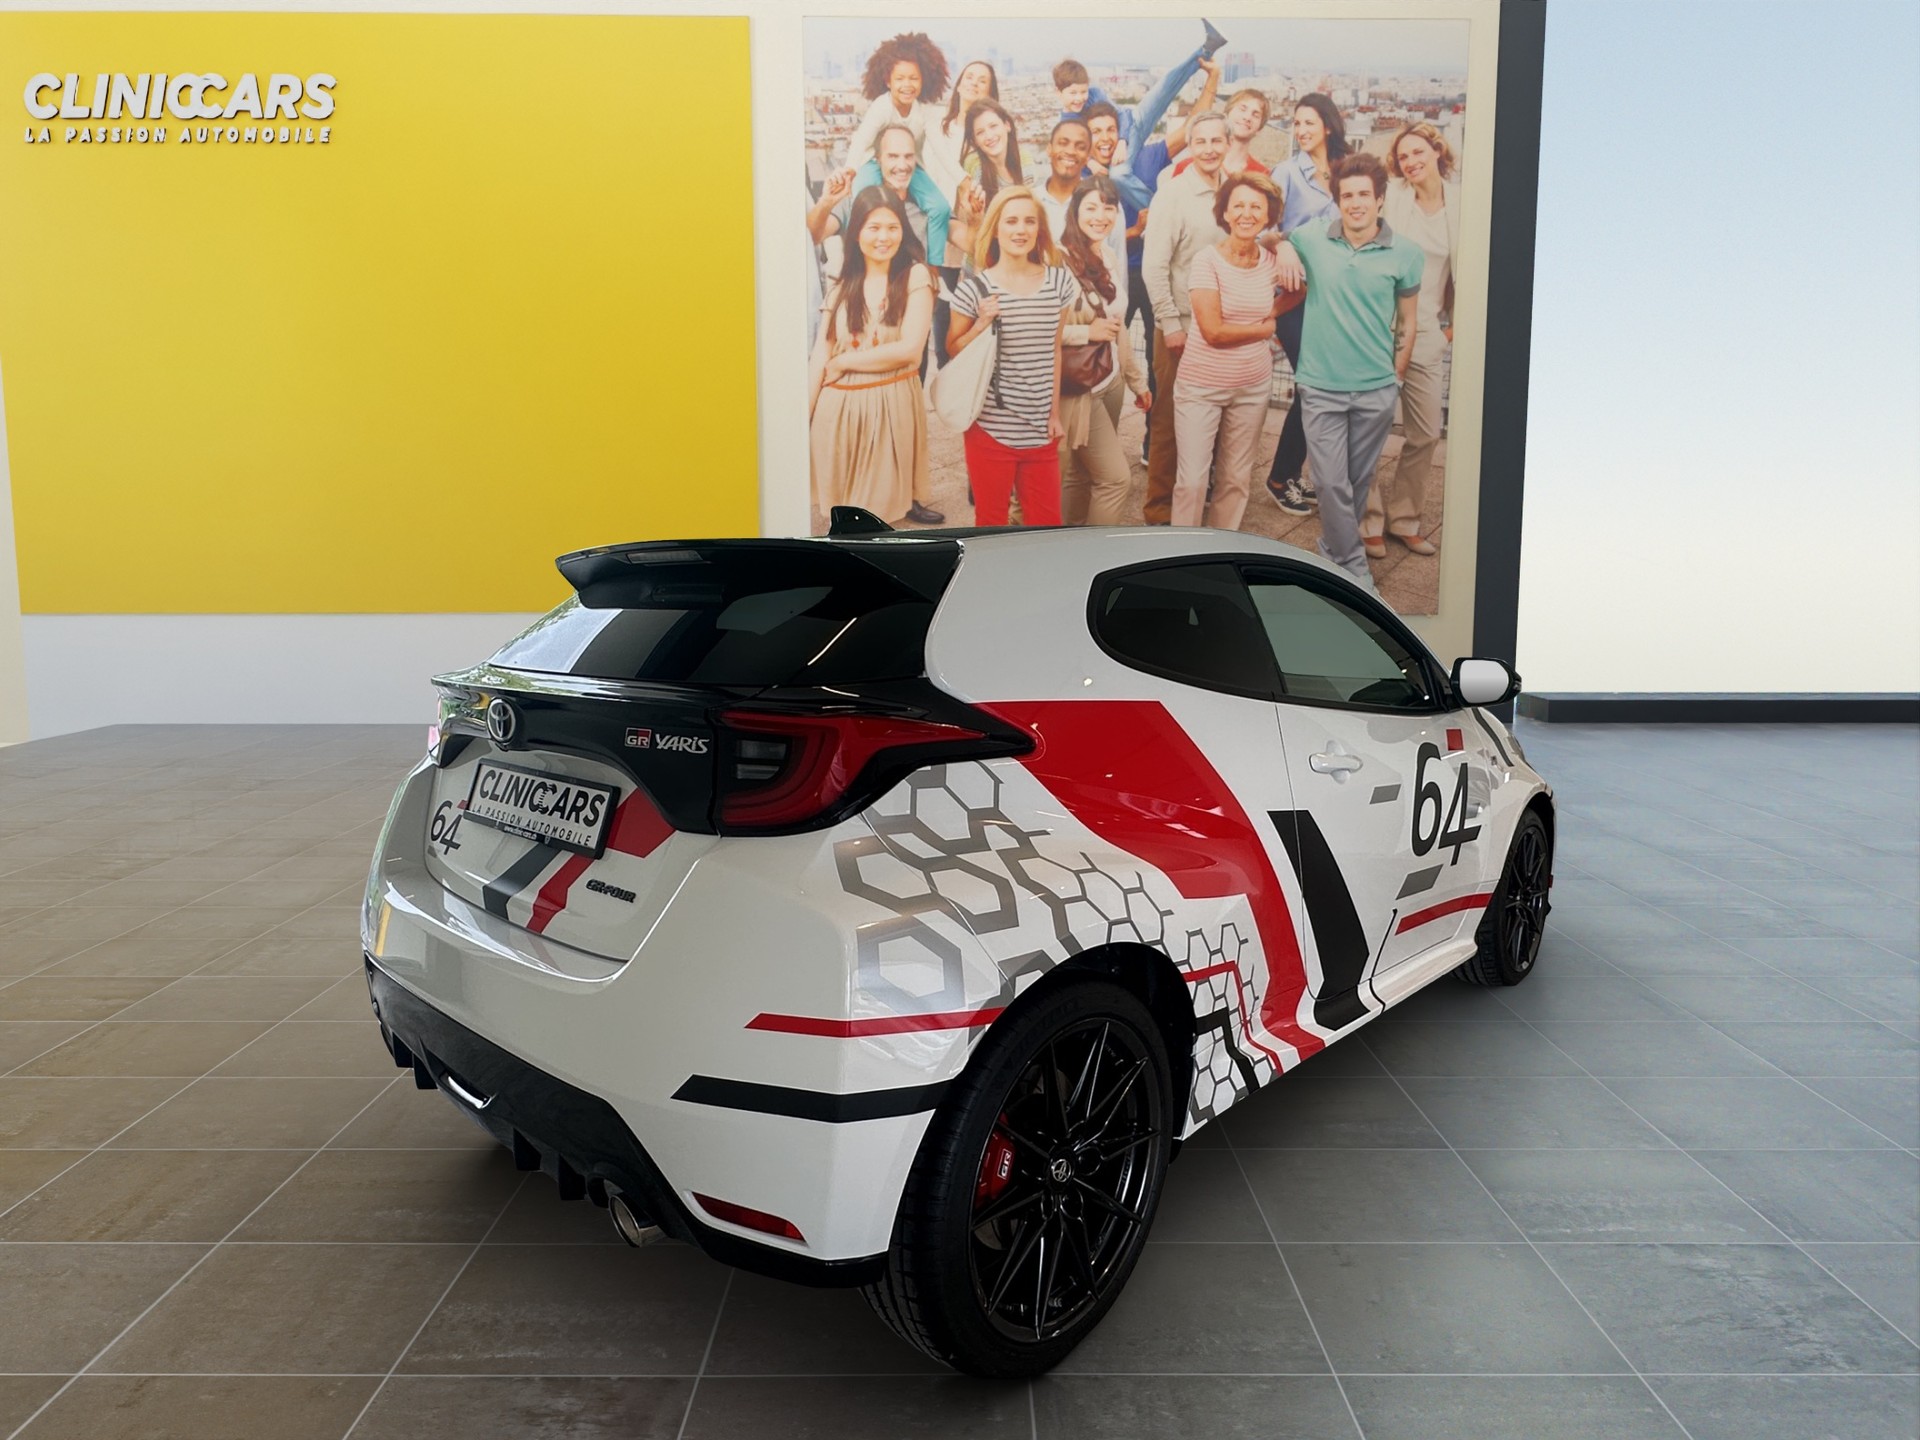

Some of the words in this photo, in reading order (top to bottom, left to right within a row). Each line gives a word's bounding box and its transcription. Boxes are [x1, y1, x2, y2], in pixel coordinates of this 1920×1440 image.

[24, 73, 337, 119] CLINICCARS
[24, 127, 52, 143] LA
[65, 127, 167, 143] PASSION
[179, 127, 333, 143] AUTOMOBILE
[627, 735, 649, 746] GR
[480, 769, 606, 827] CLINICCARS
[1411, 741, 1482, 867] 64
[431, 800, 463, 855] 64
[472, 804, 482, 813] LA
[485, 807, 522, 826] PASSION
[525, 819, 591, 846] AUTOMOBILE
[1001, 1152, 1011, 1177] GR
